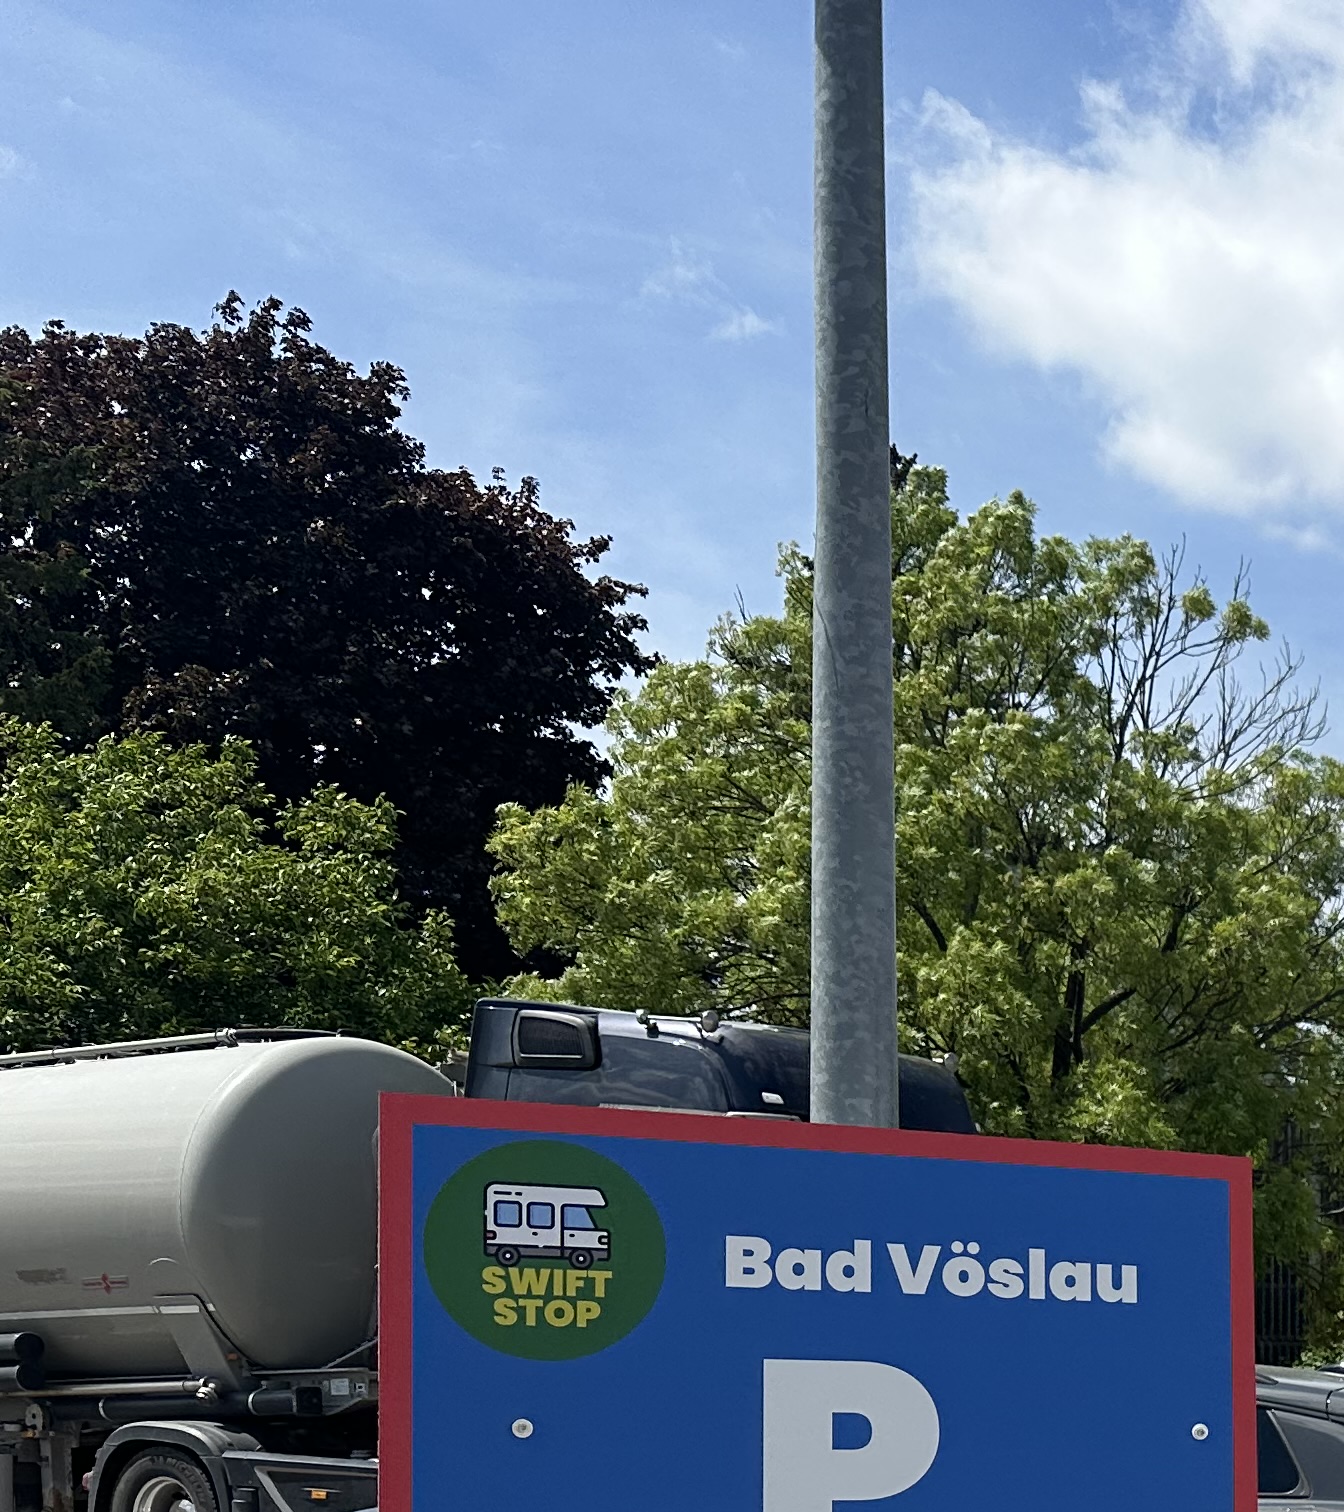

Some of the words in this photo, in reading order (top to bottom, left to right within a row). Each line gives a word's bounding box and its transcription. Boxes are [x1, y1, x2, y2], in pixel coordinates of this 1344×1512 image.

[481, 1265, 613, 1298] SWIFT
[725, 1235, 872, 1293] Bad
[887, 1240, 1138, 1304] Vöslau
[493, 1297, 601, 1328] STOP
